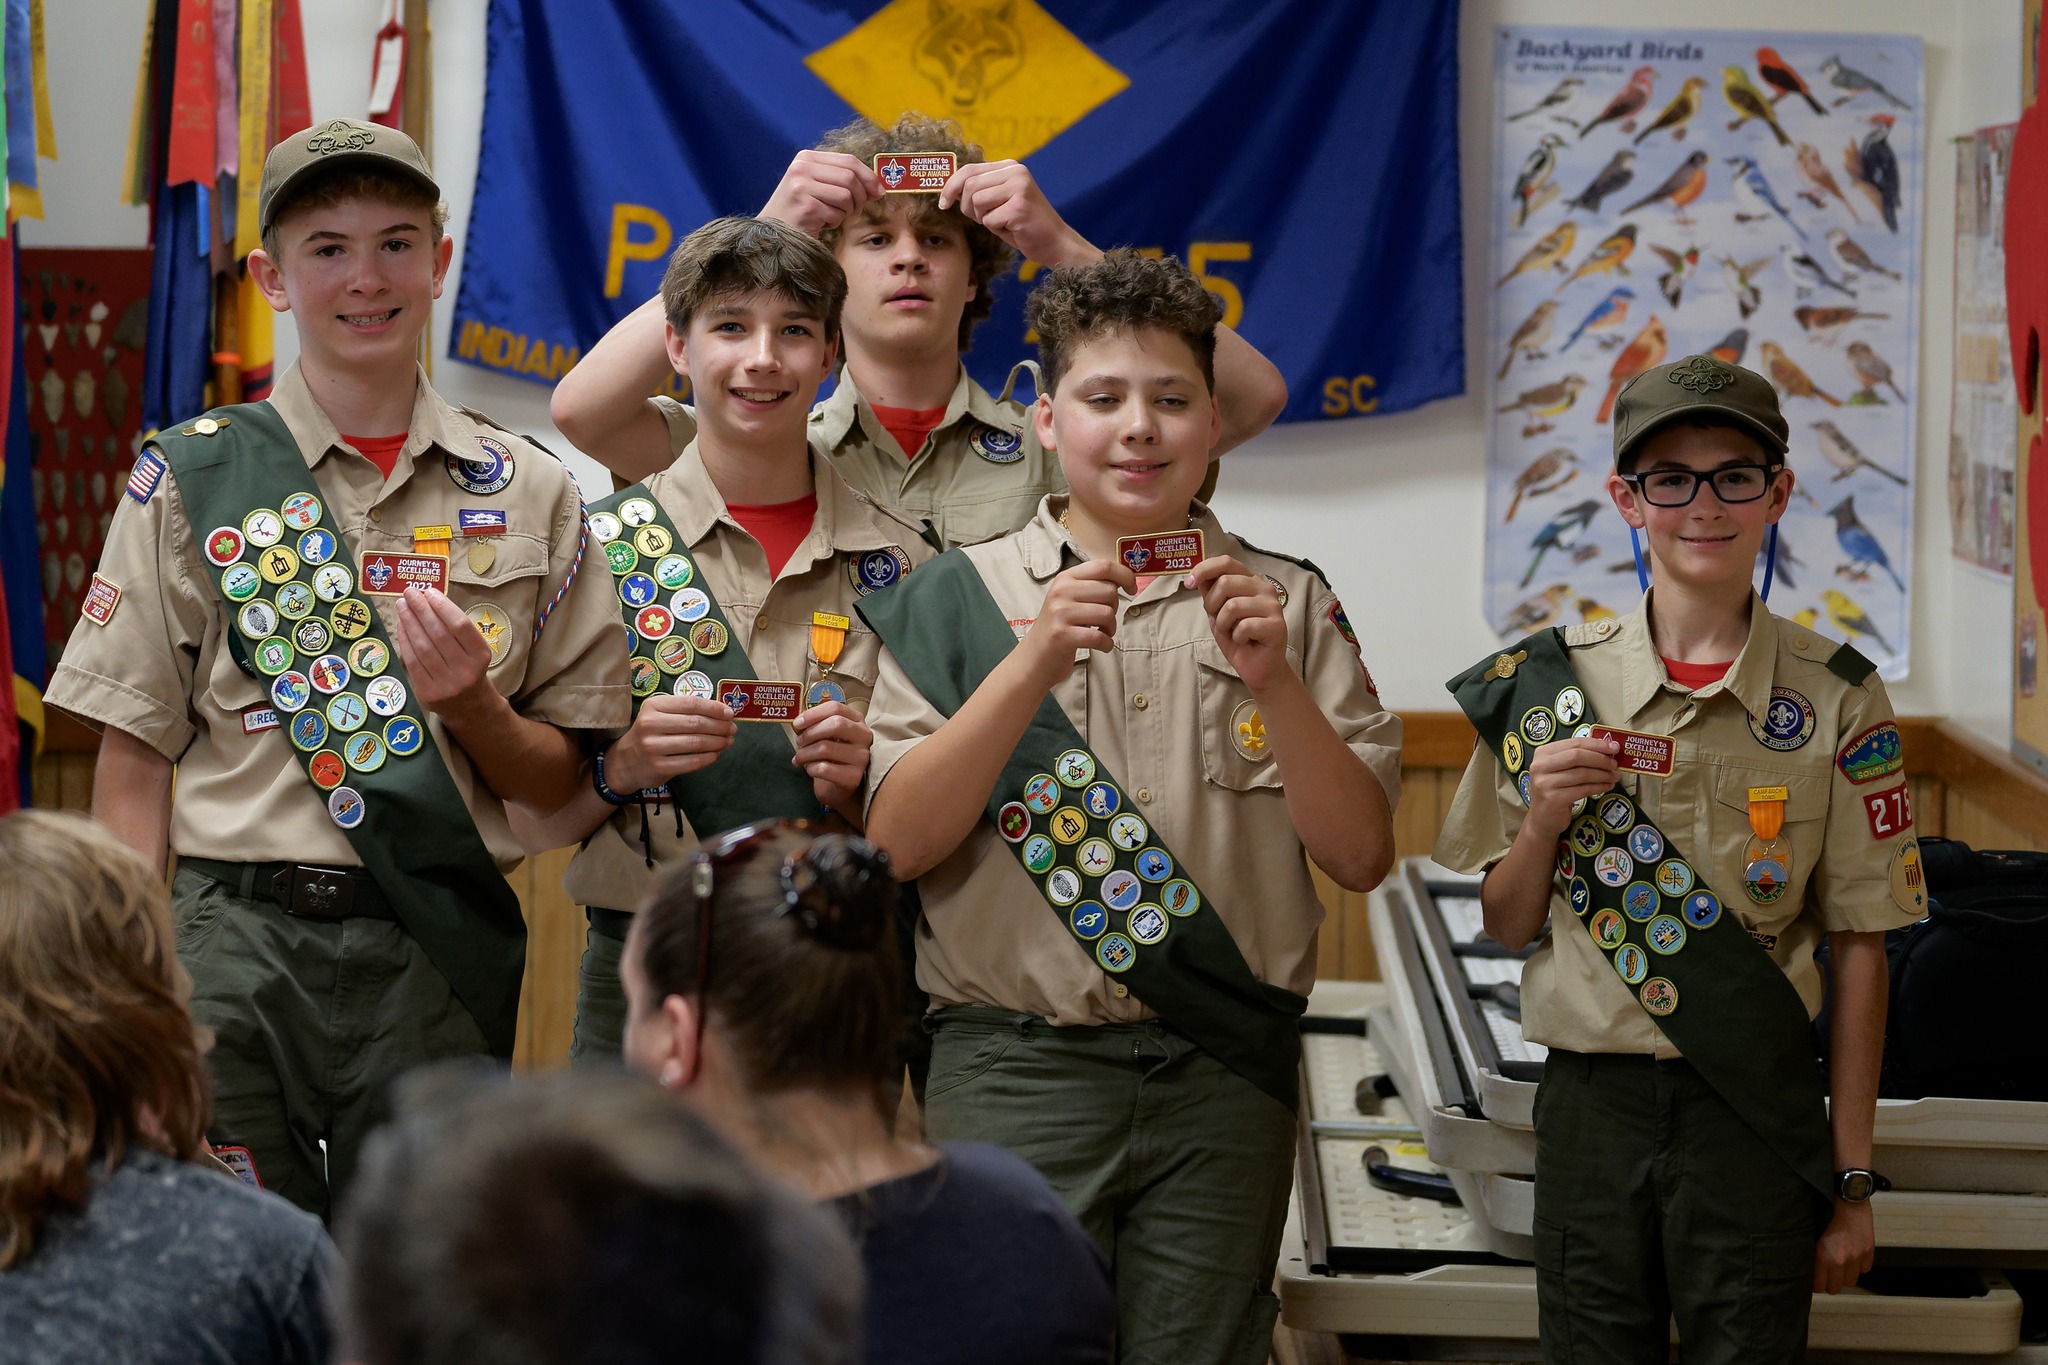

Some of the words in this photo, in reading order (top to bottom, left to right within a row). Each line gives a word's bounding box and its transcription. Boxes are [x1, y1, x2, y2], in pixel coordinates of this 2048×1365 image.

[1516, 38, 1633, 61] Backyard
[1640, 41, 1705, 61] Birds
[919, 178, 944, 187] 2023
[1322, 374, 1379, 416] SC
[1155, 537, 1186, 547] JOURNEY
[1155, 543, 1197, 553] EXCELLENCE
[1155, 551, 1173, 559] GOLD
[1173, 549, 1197, 558] AWARD
[398, 559, 431, 568] JOURNEY
[432, 561, 440, 569] to
[1165, 557, 1192, 569] 2023
[397, 566, 441, 576] EXCELLENCE
[397, 572, 414, 580] GOLD
[415, 574, 440, 582] AWARD
[753, 692, 795, 701] EXCELLENCE
[762, 707, 788, 717] 2023
[1626, 736, 1659, 747] JOURNEY
[1845, 729, 1879, 759] PALMETTO
[1624, 742, 1668, 755] EXCELLENCE
[1624, 749, 1642, 757] GOLD
[1642, 752, 1667, 762] AWARD
[1632, 758, 1659, 771] 2023
[1857, 764, 1885, 779] SOUTH
